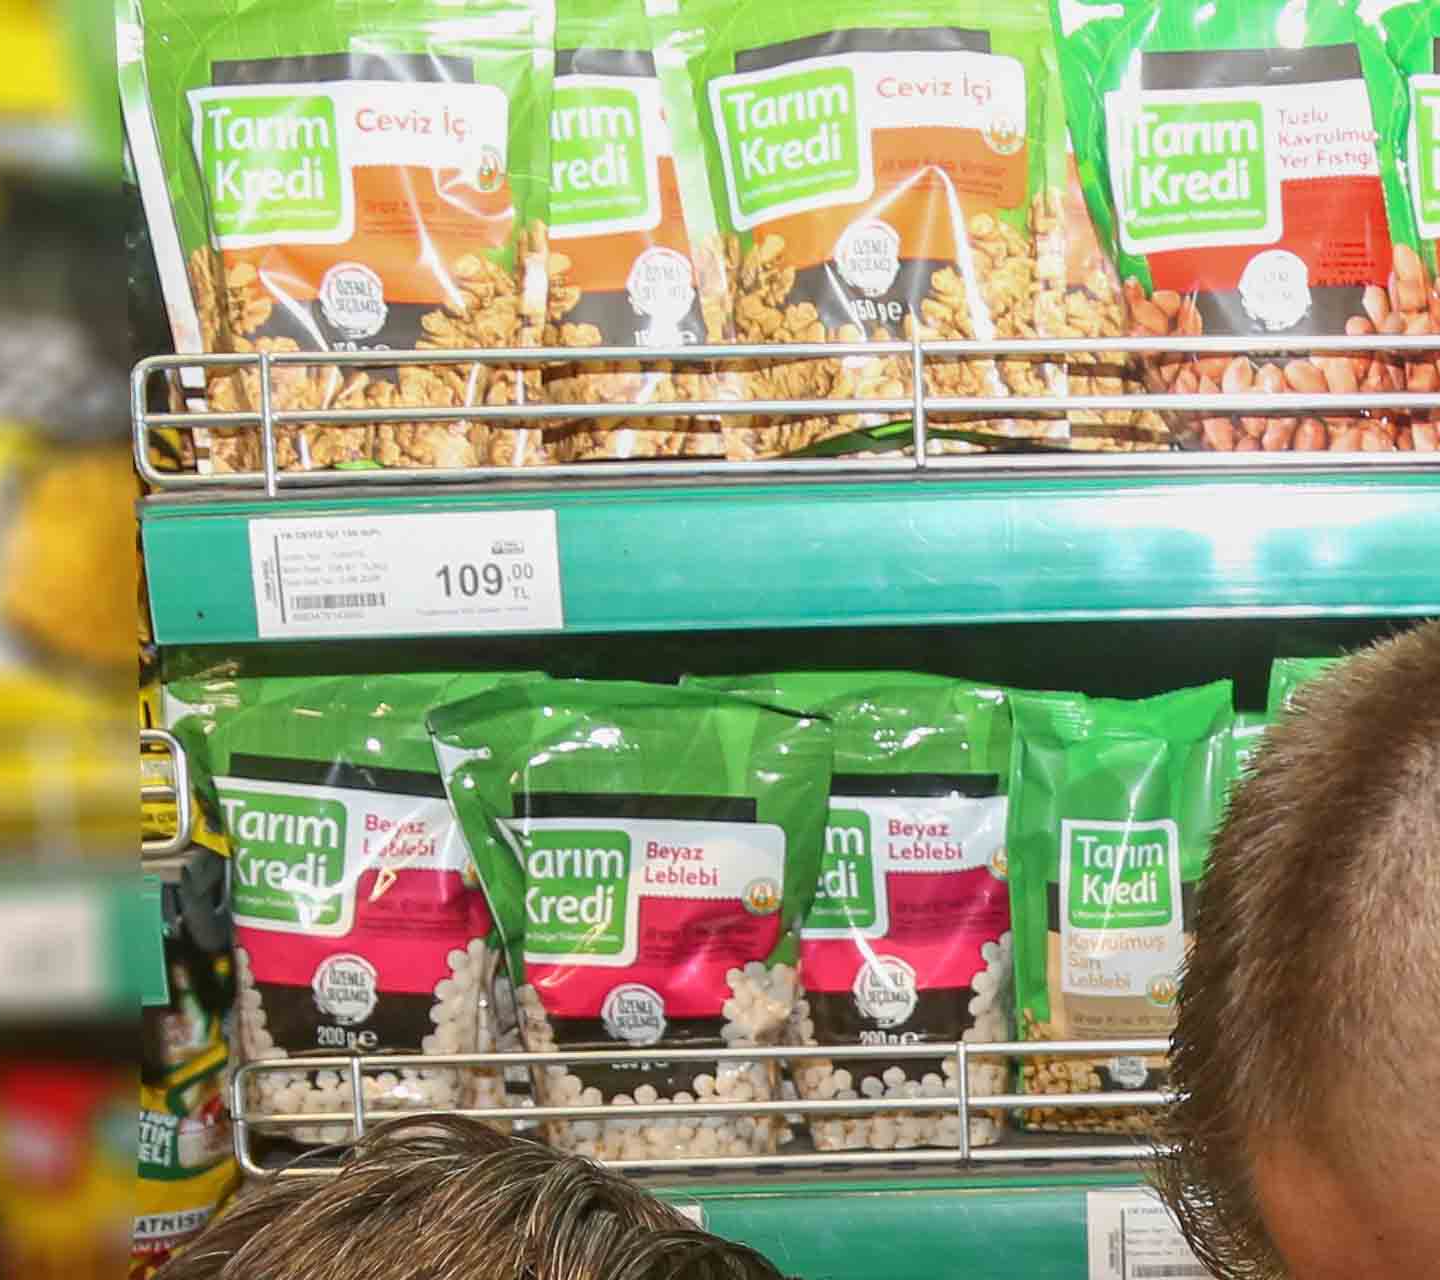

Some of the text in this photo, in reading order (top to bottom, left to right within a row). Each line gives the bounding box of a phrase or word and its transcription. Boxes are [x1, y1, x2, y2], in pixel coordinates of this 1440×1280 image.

[876, 71, 993, 105] Ceviz İçi
[354, 106, 433, 134] Ceviz
[727, 81, 850, 132] Tarım
[1277, 106, 1329, 126] Tuzlu
[208, 106, 331, 151] Tarım
[1127, 107, 1258, 154] Tarım
[550, 143, 628, 191] redi
[739, 124, 843, 181] Kredi
[1278, 148, 1306, 169] Yer
[214, 155, 326, 202] Kredi
[1137, 156, 1252, 204] Kredi
[512, 585, 530, 600] TL
[224, 800, 340, 848] Tarım
[888, 819, 950, 842] Beyaz
[526, 843, 624, 880] arım
[646, 841, 704, 863] Beyaz
[888, 841, 964, 862] Leblebi
[1077, 836, 1164, 869] Tarım
[645, 865, 720, 887] Leblebi
[1083, 871, 1158, 906] Kredi
